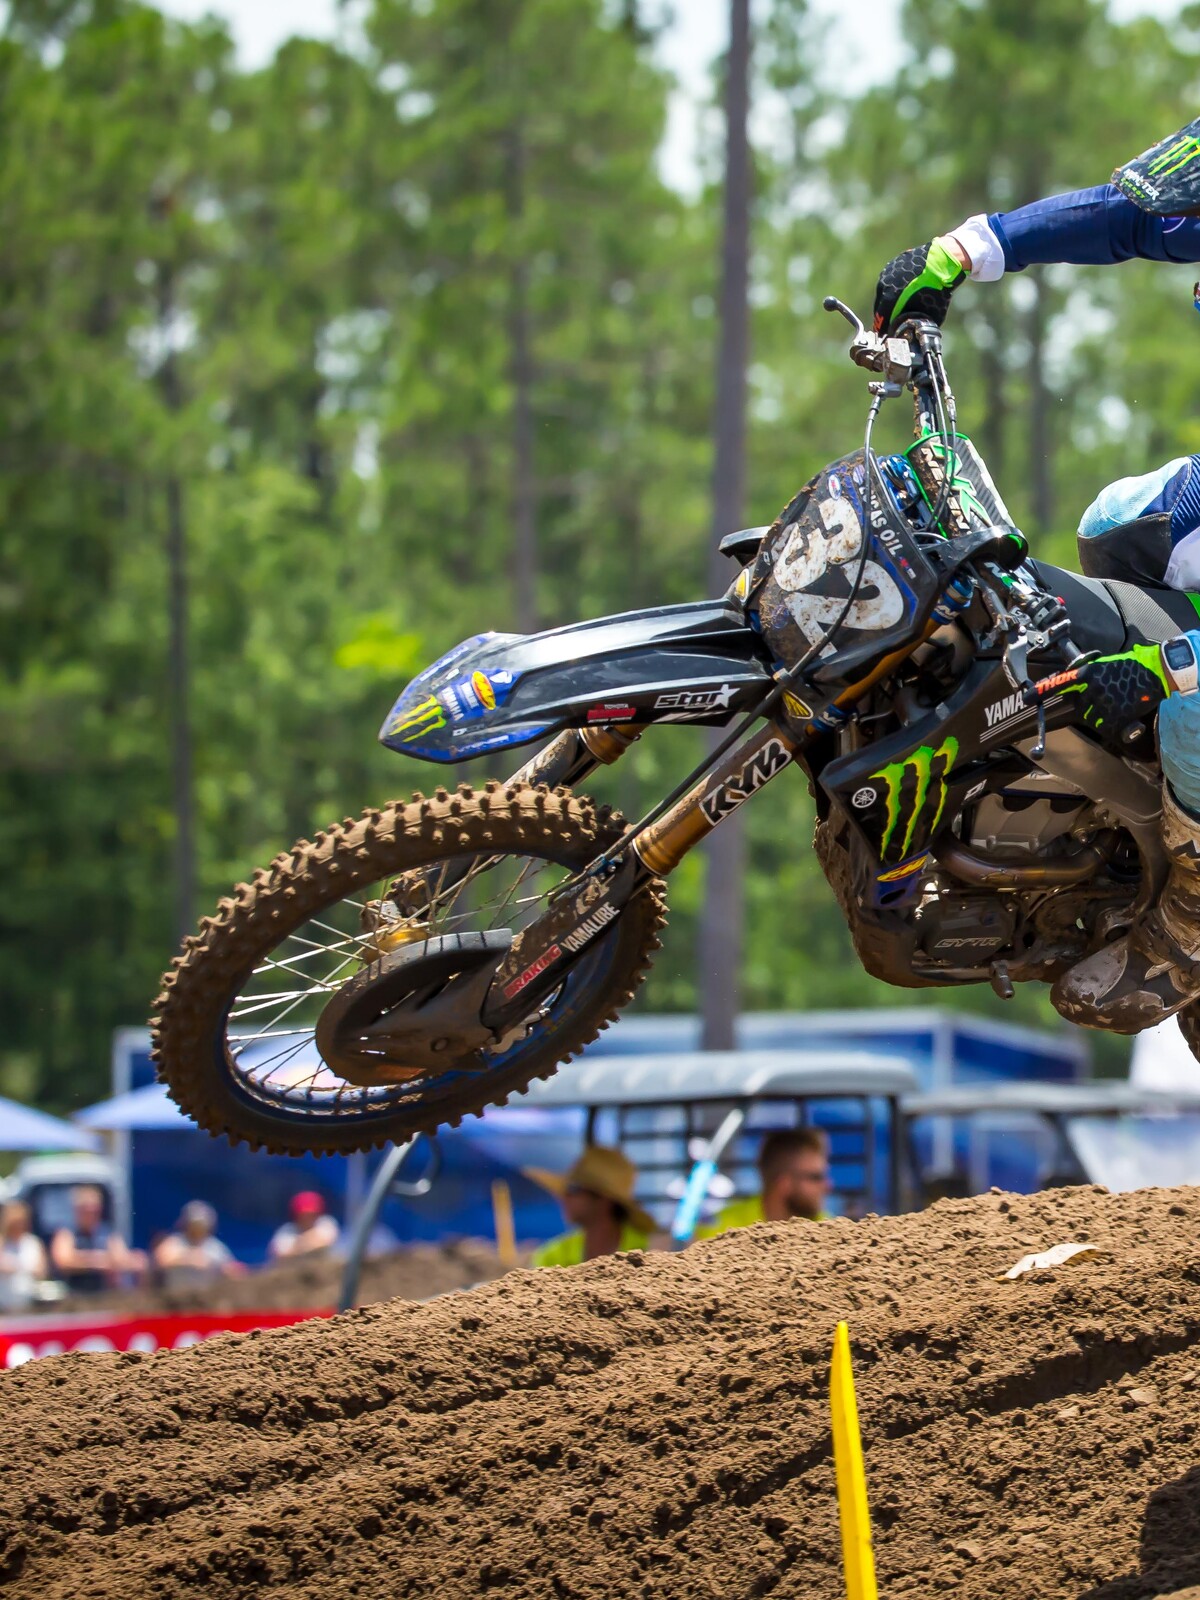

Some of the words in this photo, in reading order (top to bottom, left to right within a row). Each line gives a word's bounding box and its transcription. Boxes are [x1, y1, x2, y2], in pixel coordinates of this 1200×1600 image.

[858, 485, 888, 529] LCAS
[879, 528, 904, 557] OIL
[772, 497, 905, 660] 32
[984, 689, 1028, 728] YAMA
[1034, 668, 1080, 695] THOR
[699, 737, 793, 827] KYB
[561, 901, 621, 953] YAMALUBE
